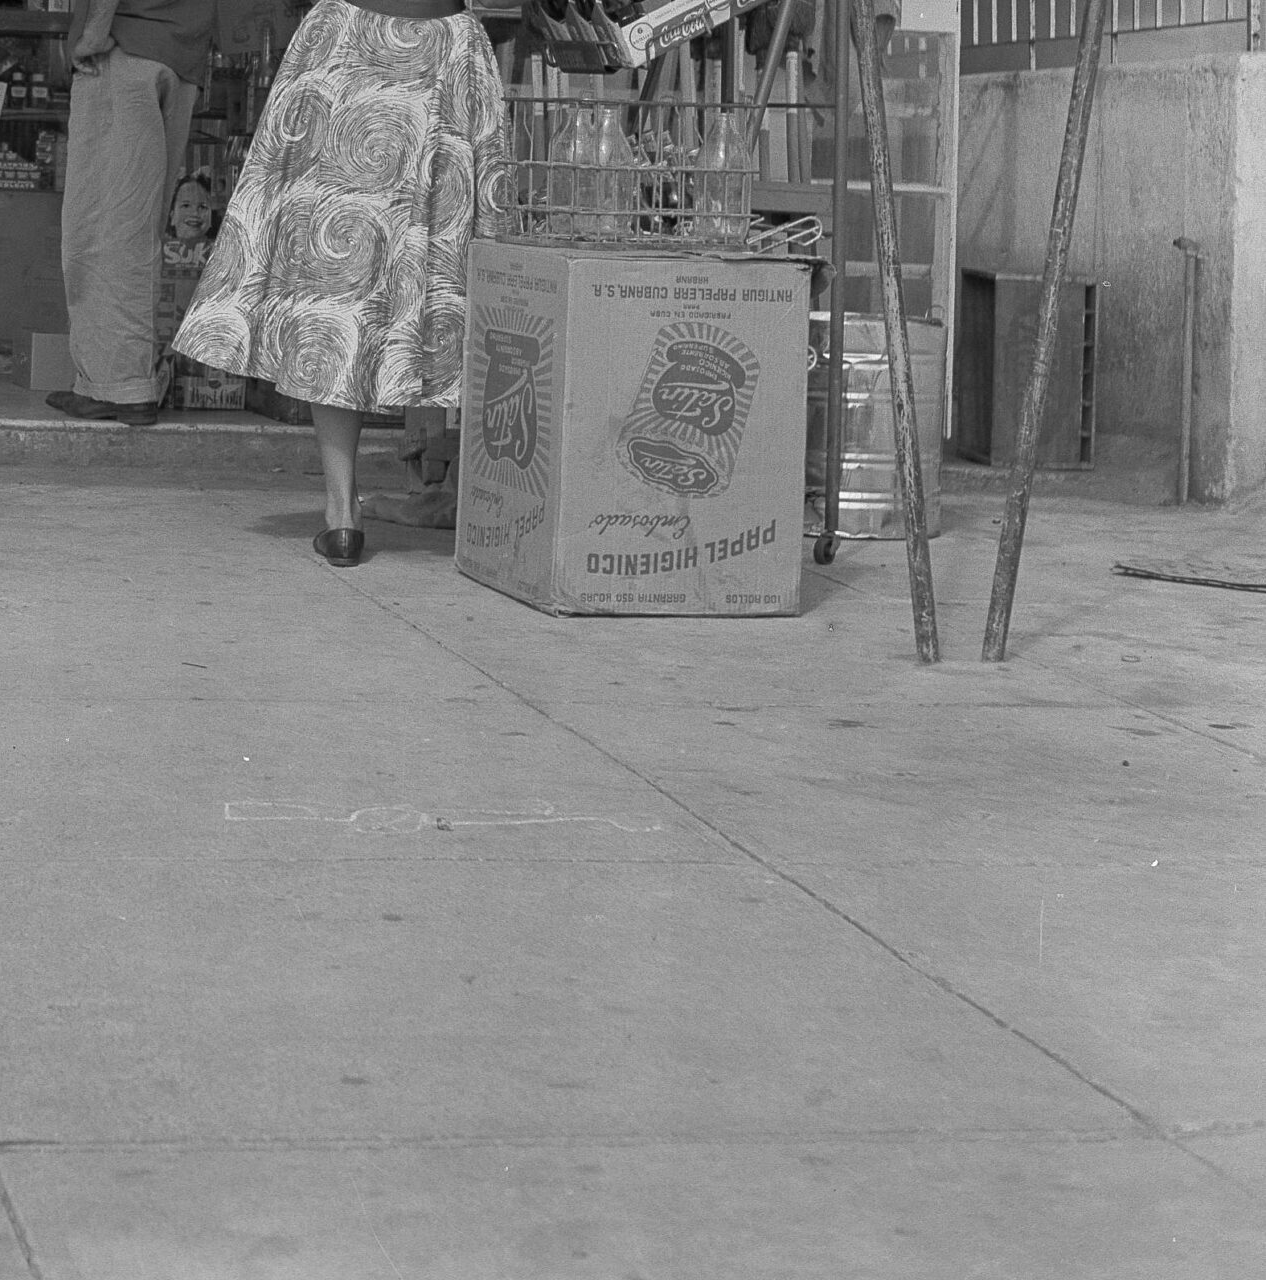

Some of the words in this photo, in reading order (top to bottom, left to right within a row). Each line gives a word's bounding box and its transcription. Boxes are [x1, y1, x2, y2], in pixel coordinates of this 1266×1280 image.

[676, 275, 709, 285] HABANA
[617, 284, 668, 300] CUBANA,
[674, 287, 737, 301] PAPELERA
[742, 288, 793, 302] ANTIGUA
[649, 310, 671, 318] CUBA
[674, 310, 685, 318] EN
[688, 311, 731, 319] FABRICADO
[681, 349, 730, 370] ABSORBENTE
[514, 502, 546, 546] PAPEL
[589, 513, 691, 539] Embosado
[466, 522, 511, 548] HIGIENICO
[705, 519, 777, 564] PAPEL
[586, 546, 698, 576] HIGIENICO
[580, 592, 612, 602] HOJAS
[638, 593, 687, 603] GARANTIA
[725, 594, 761, 604] ROLLOS
[764, 594, 781, 604] 100
